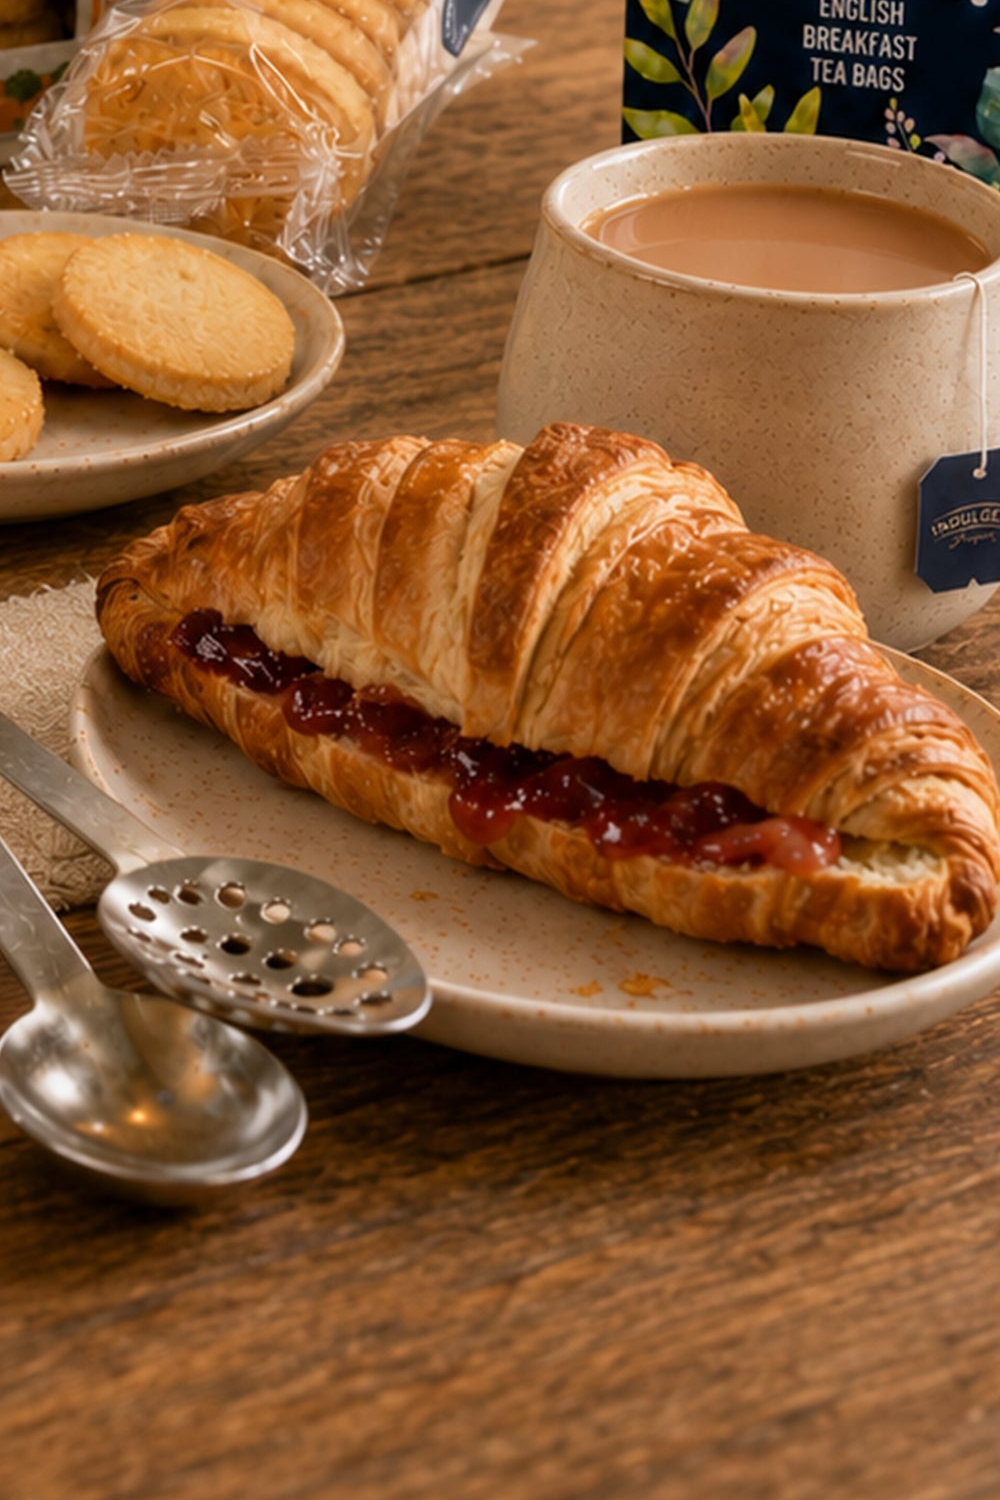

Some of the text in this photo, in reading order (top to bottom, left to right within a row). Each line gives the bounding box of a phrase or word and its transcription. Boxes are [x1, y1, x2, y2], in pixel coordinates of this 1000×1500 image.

[802, 24, 918, 61] BREAKFAST
[810, 56, 905, 92] TEA BAGS
